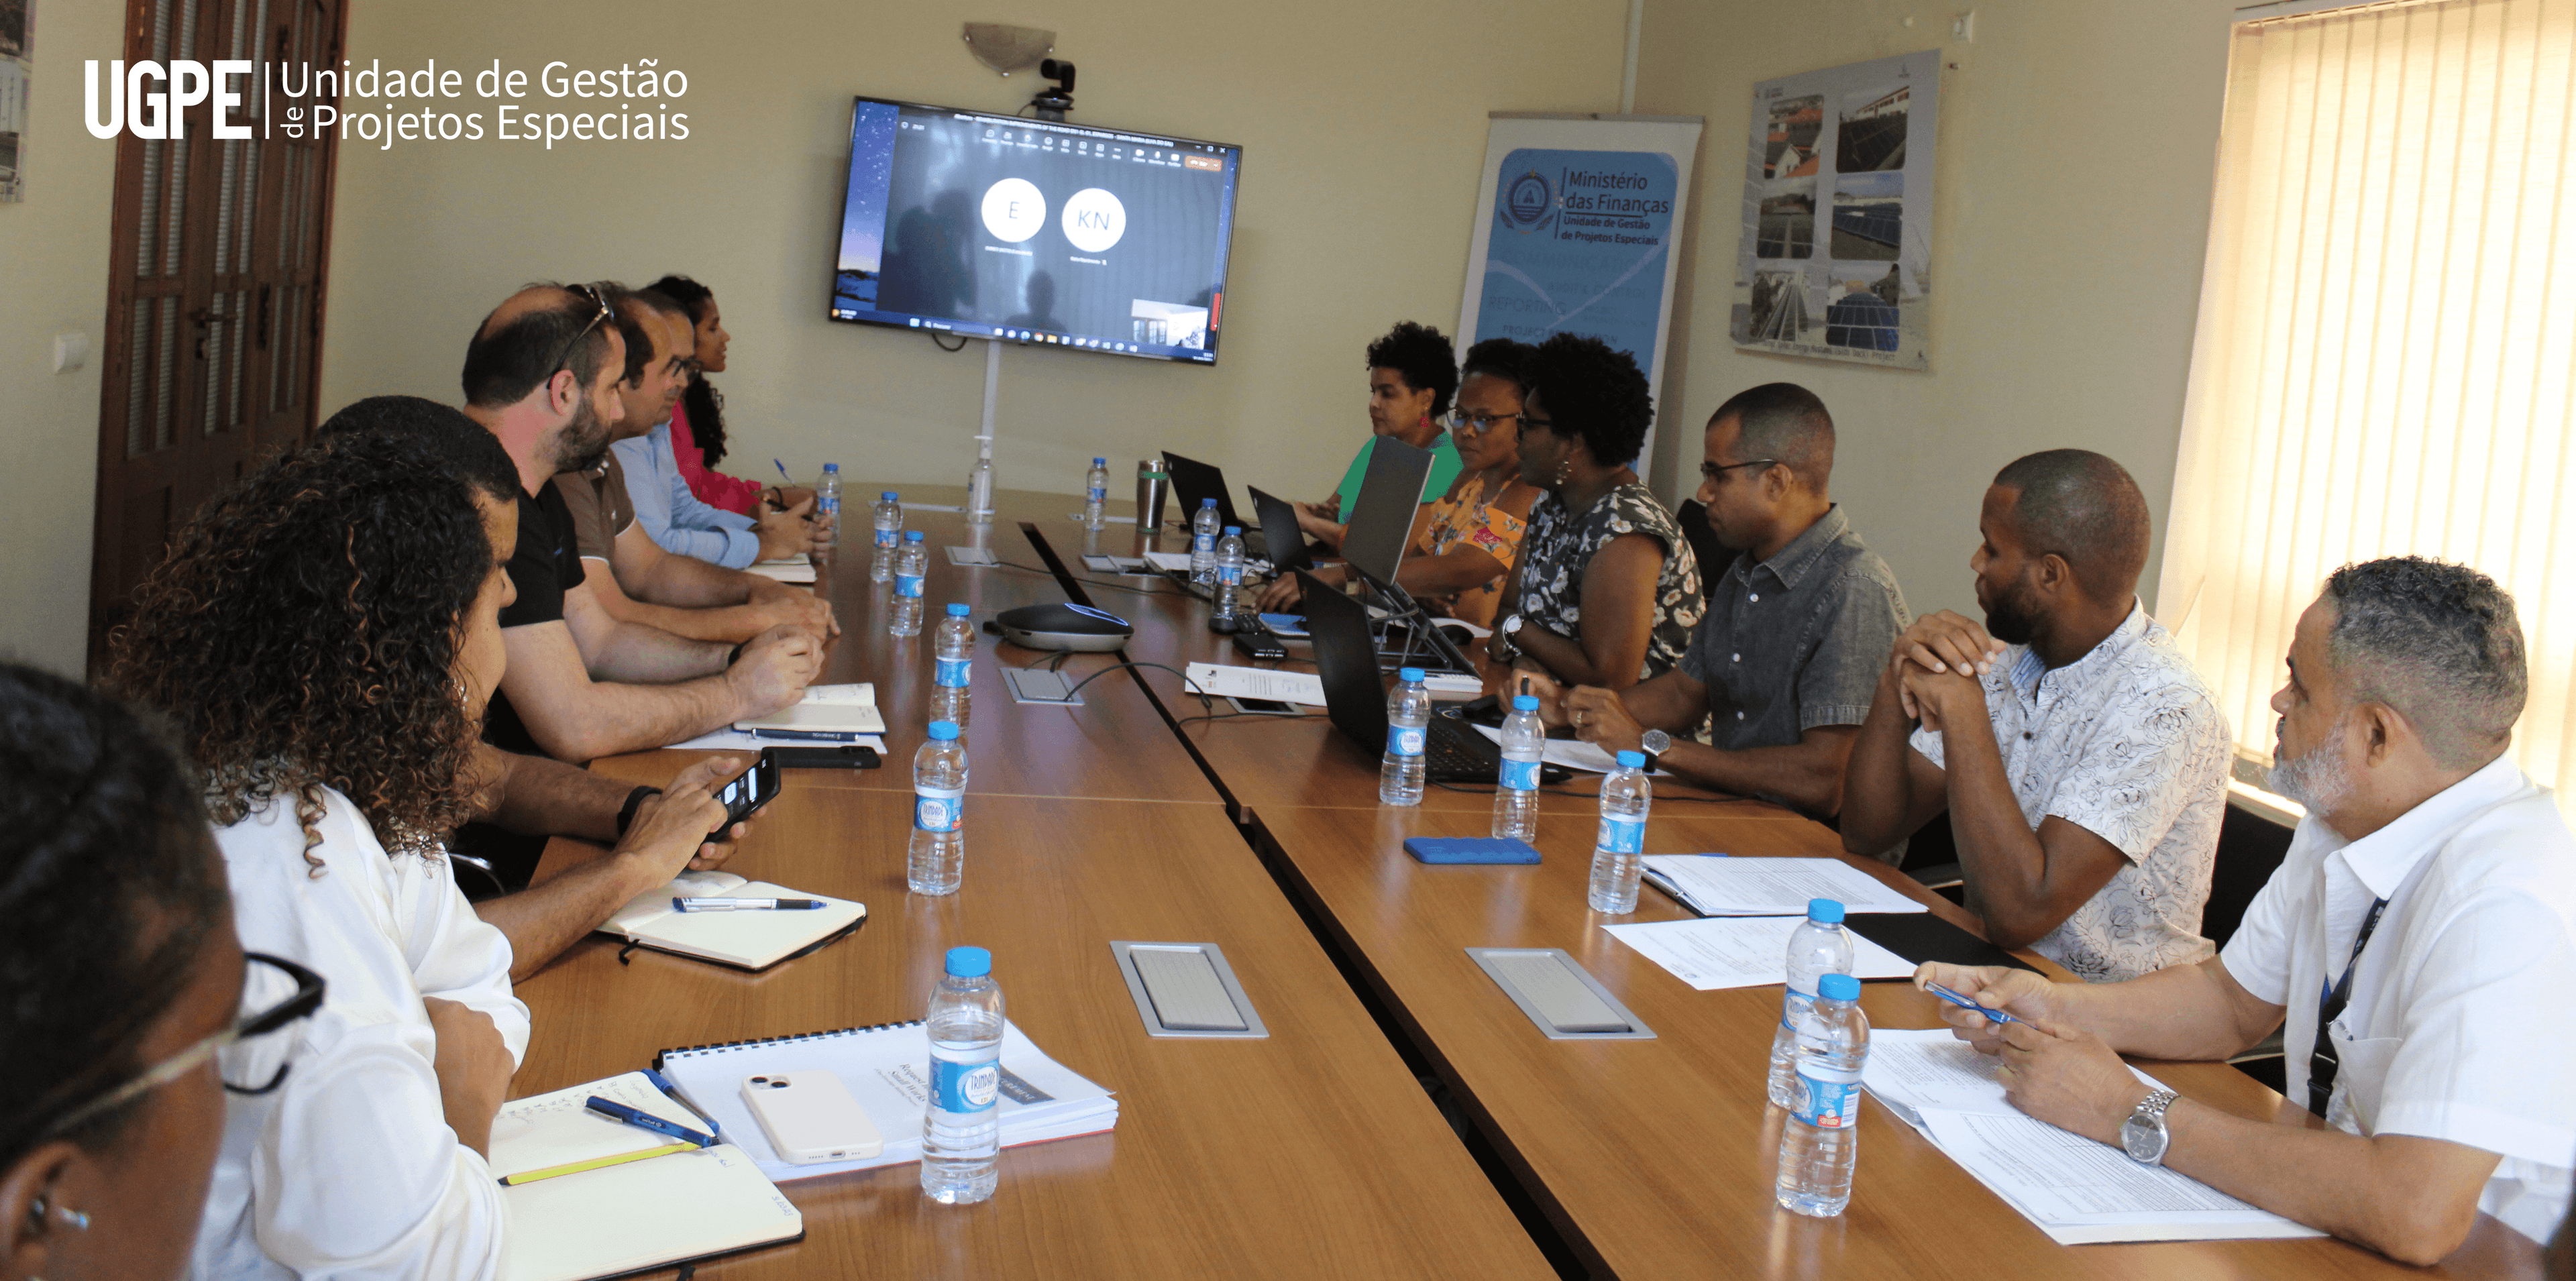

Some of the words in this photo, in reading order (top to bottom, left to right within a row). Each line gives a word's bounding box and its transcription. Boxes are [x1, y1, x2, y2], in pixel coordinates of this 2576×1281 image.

[1569, 170, 1648, 190] Ministério
[1008, 201, 1020, 220] E
[1566, 192, 1593, 210] das
[1597, 194, 1669, 216] Finanças
[1077, 209, 1110, 231] KN
[1563, 215, 1602, 228] Unidade
[1603, 218, 1615, 228] de
[1617, 217, 1651, 230] Gestão
[1561, 231, 1573, 241] de
[1575, 231, 1613, 244] Projetos
[1615, 233, 1659, 246] Especiais
[1489, 295, 1567, 315] REPORTING
